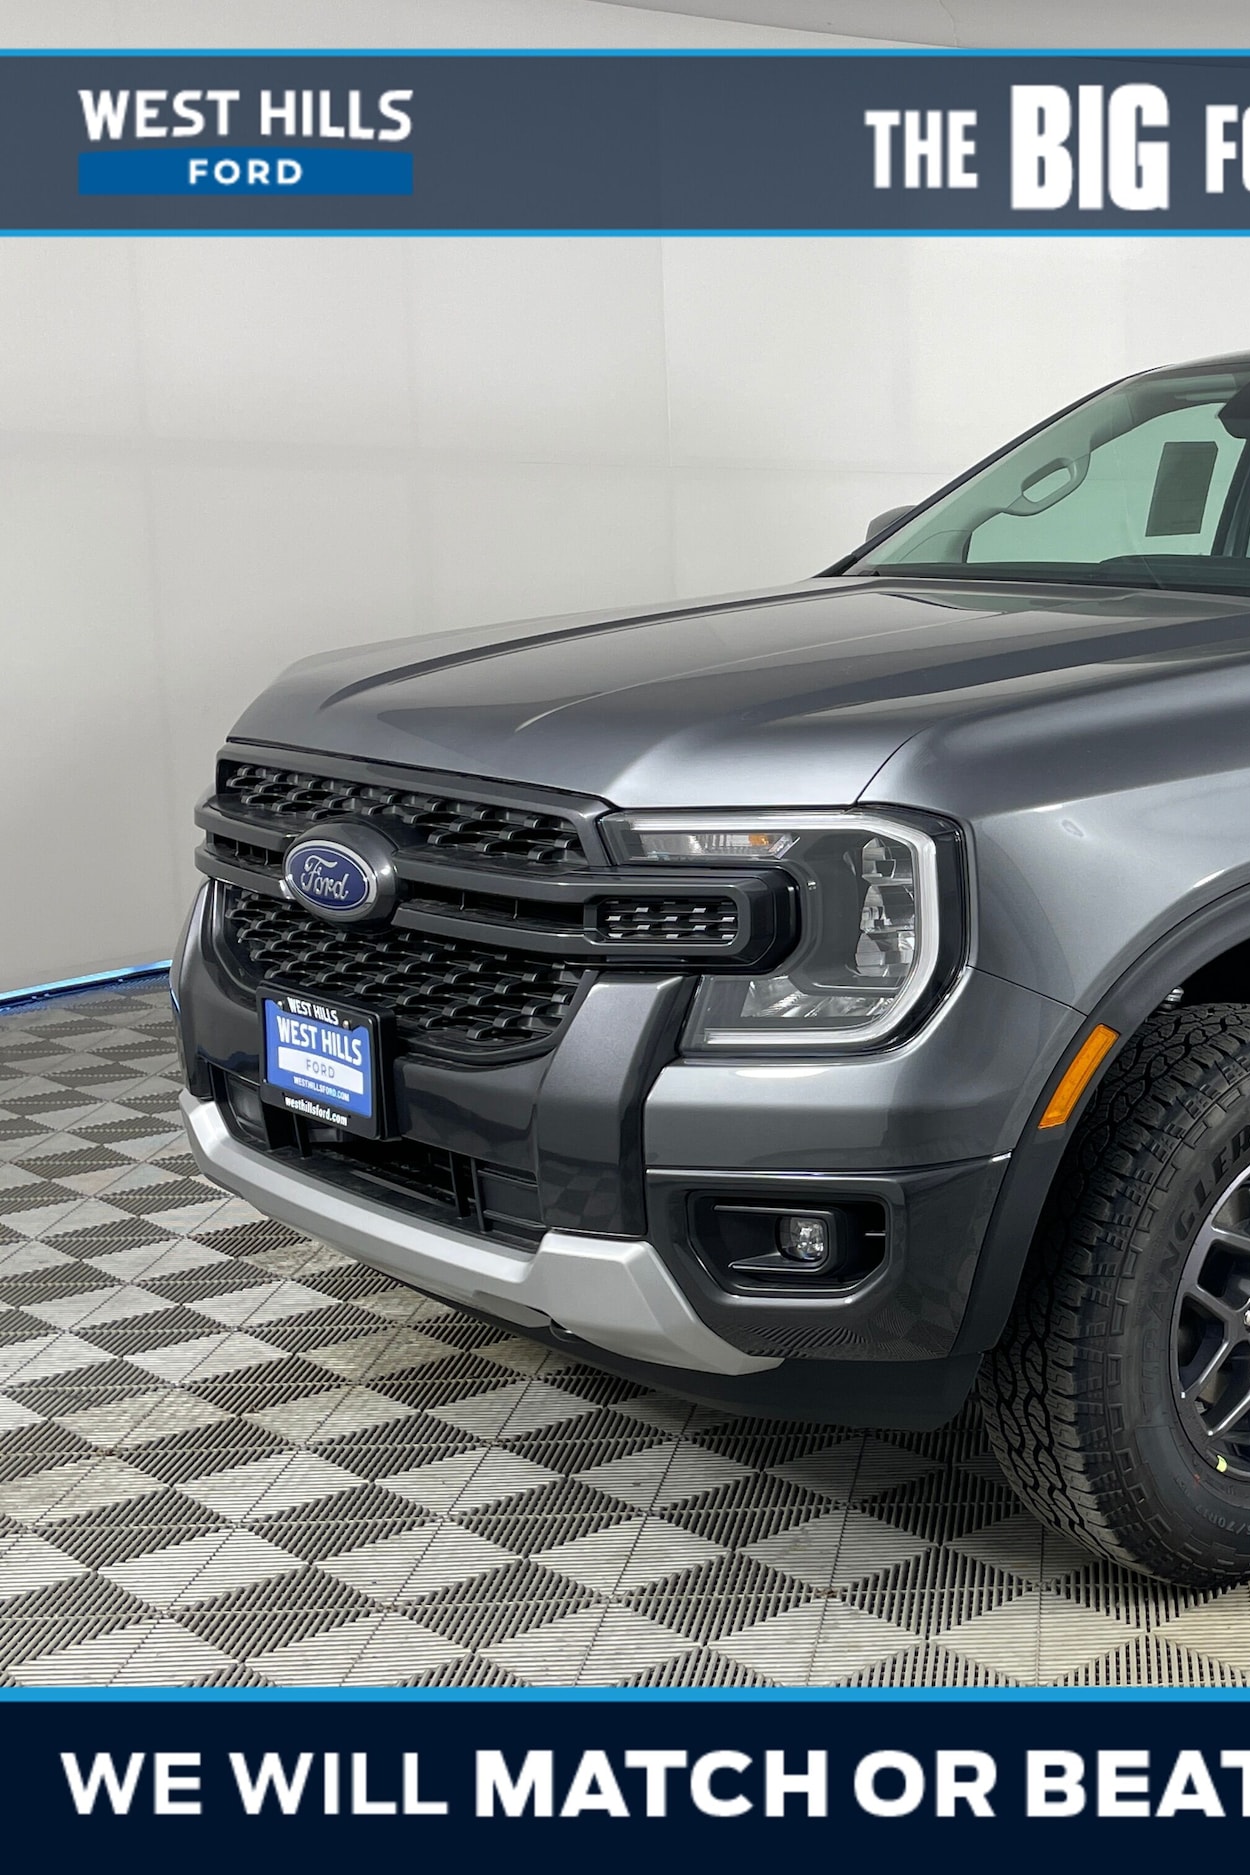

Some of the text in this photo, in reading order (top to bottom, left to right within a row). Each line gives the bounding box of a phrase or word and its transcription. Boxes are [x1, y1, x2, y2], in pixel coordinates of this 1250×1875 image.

[301, 855, 349, 900] Ford
[287, 997, 339, 1026] WEST HILLS
[276, 1016, 362, 1066] WEST HILLS
[306, 1059, 335, 1079] FORD
[293, 1076, 350, 1102] WESTHILLSFORD.COM
[285, 1096, 348, 1126] westhillsford.com
